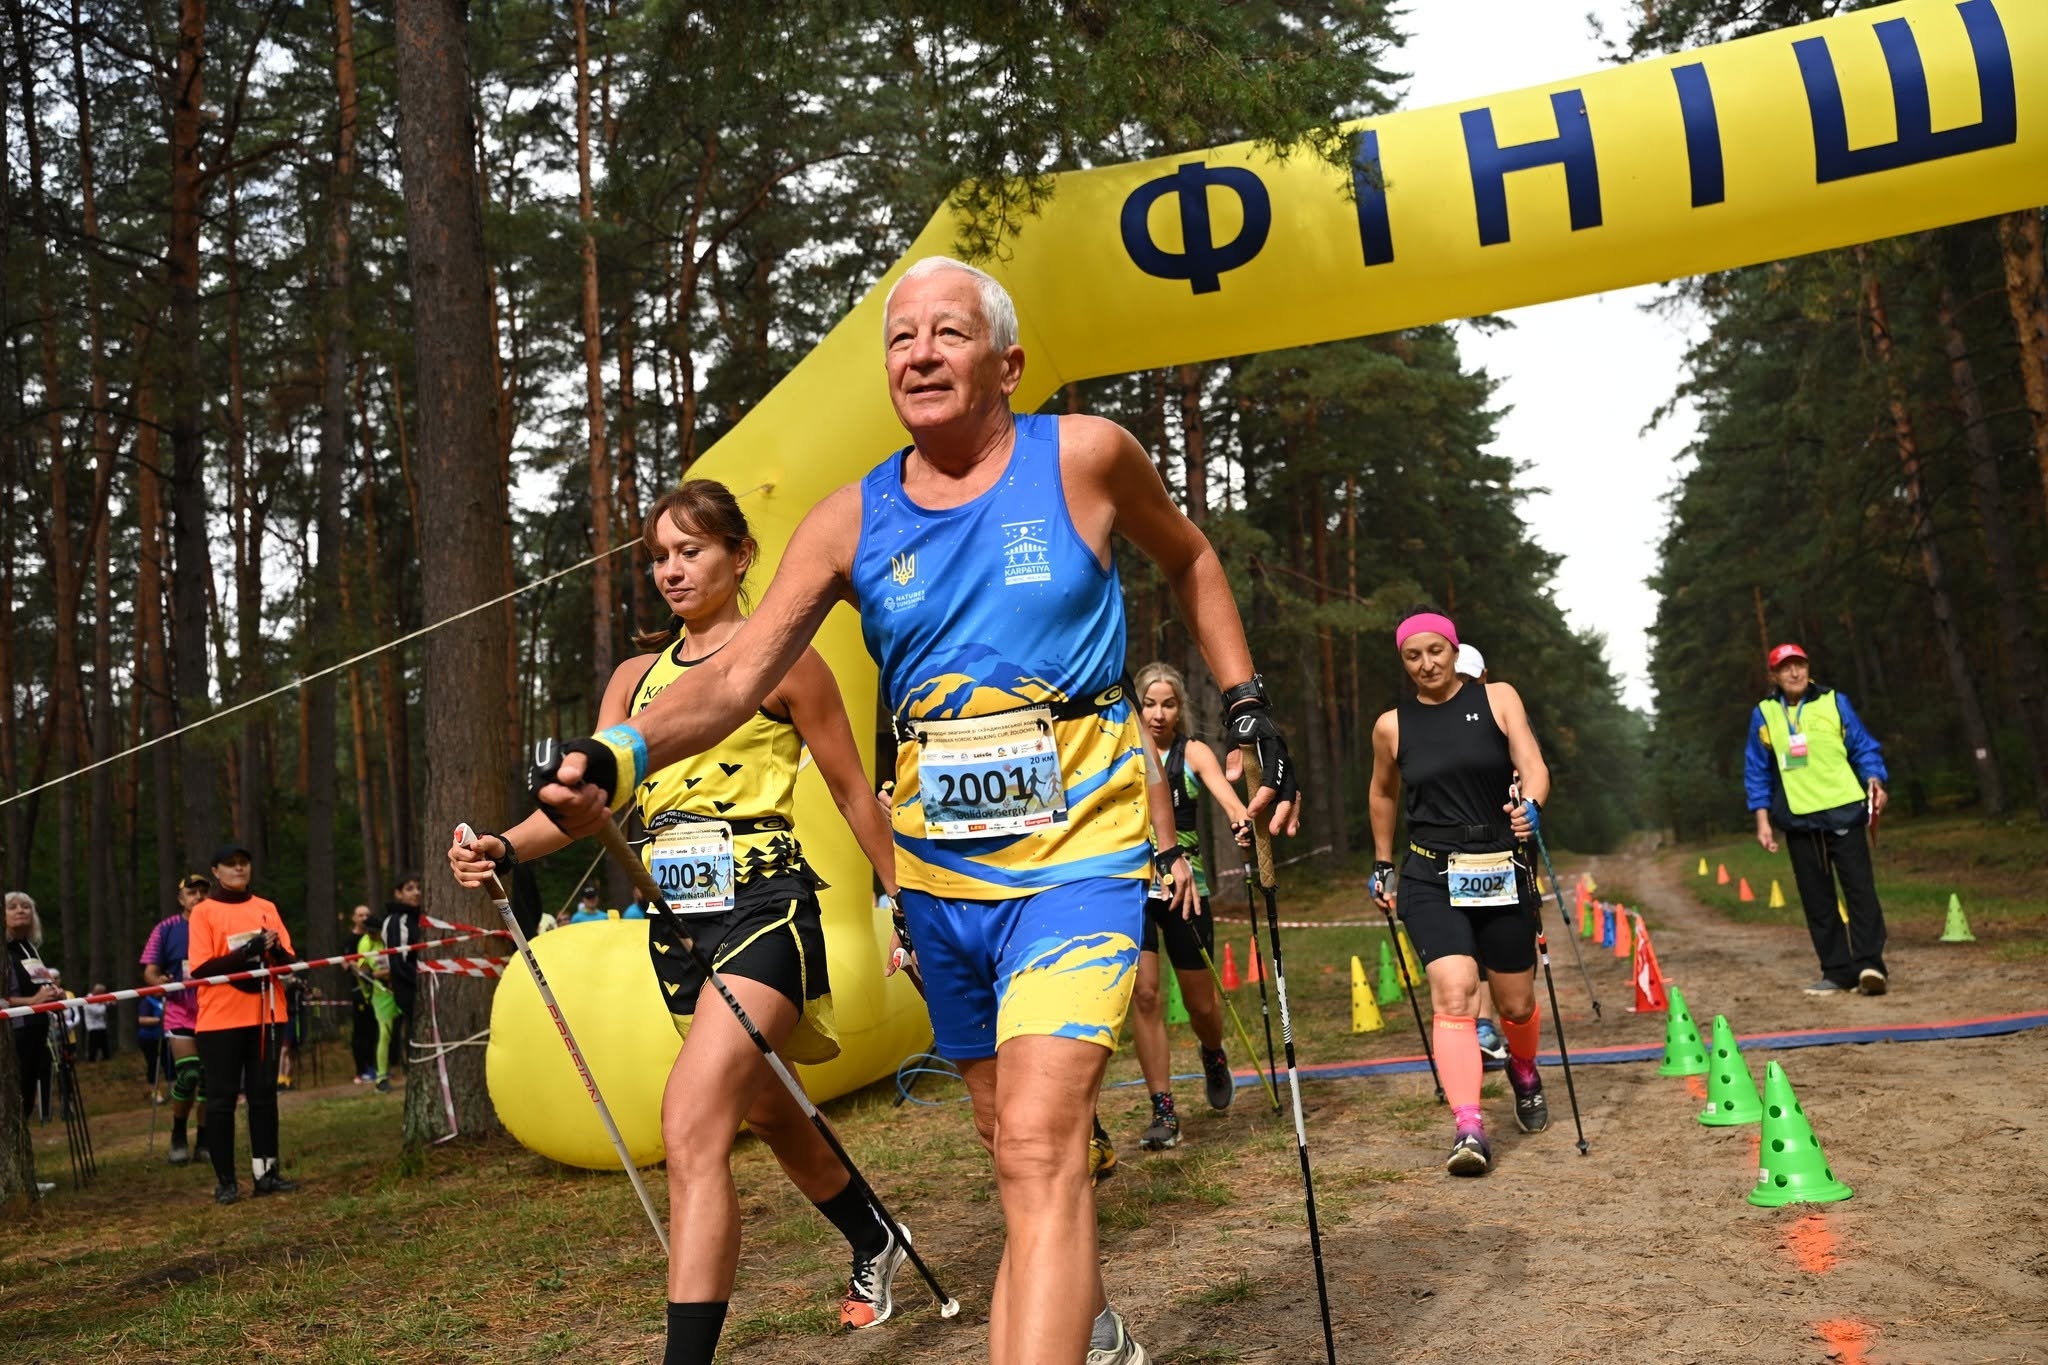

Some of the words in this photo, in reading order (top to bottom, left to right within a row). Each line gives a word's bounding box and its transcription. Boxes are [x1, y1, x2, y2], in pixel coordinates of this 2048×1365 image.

[1120, 0, 2018, 295] ФІНІШ
[1004, 564, 1051, 577] KARPATIYA
[973, 731, 998, 741] WALKING
[1030, 756, 1041, 765] 20
[1276, 758, 1284, 786] LEKI
[938, 766, 1034, 807] 2001
[995, 806, 1028, 817] Sergiy
[658, 862, 714, 890] 2003
[1459, 876, 1504, 892] 2002
[547, 1004, 600, 1103] PASSION
